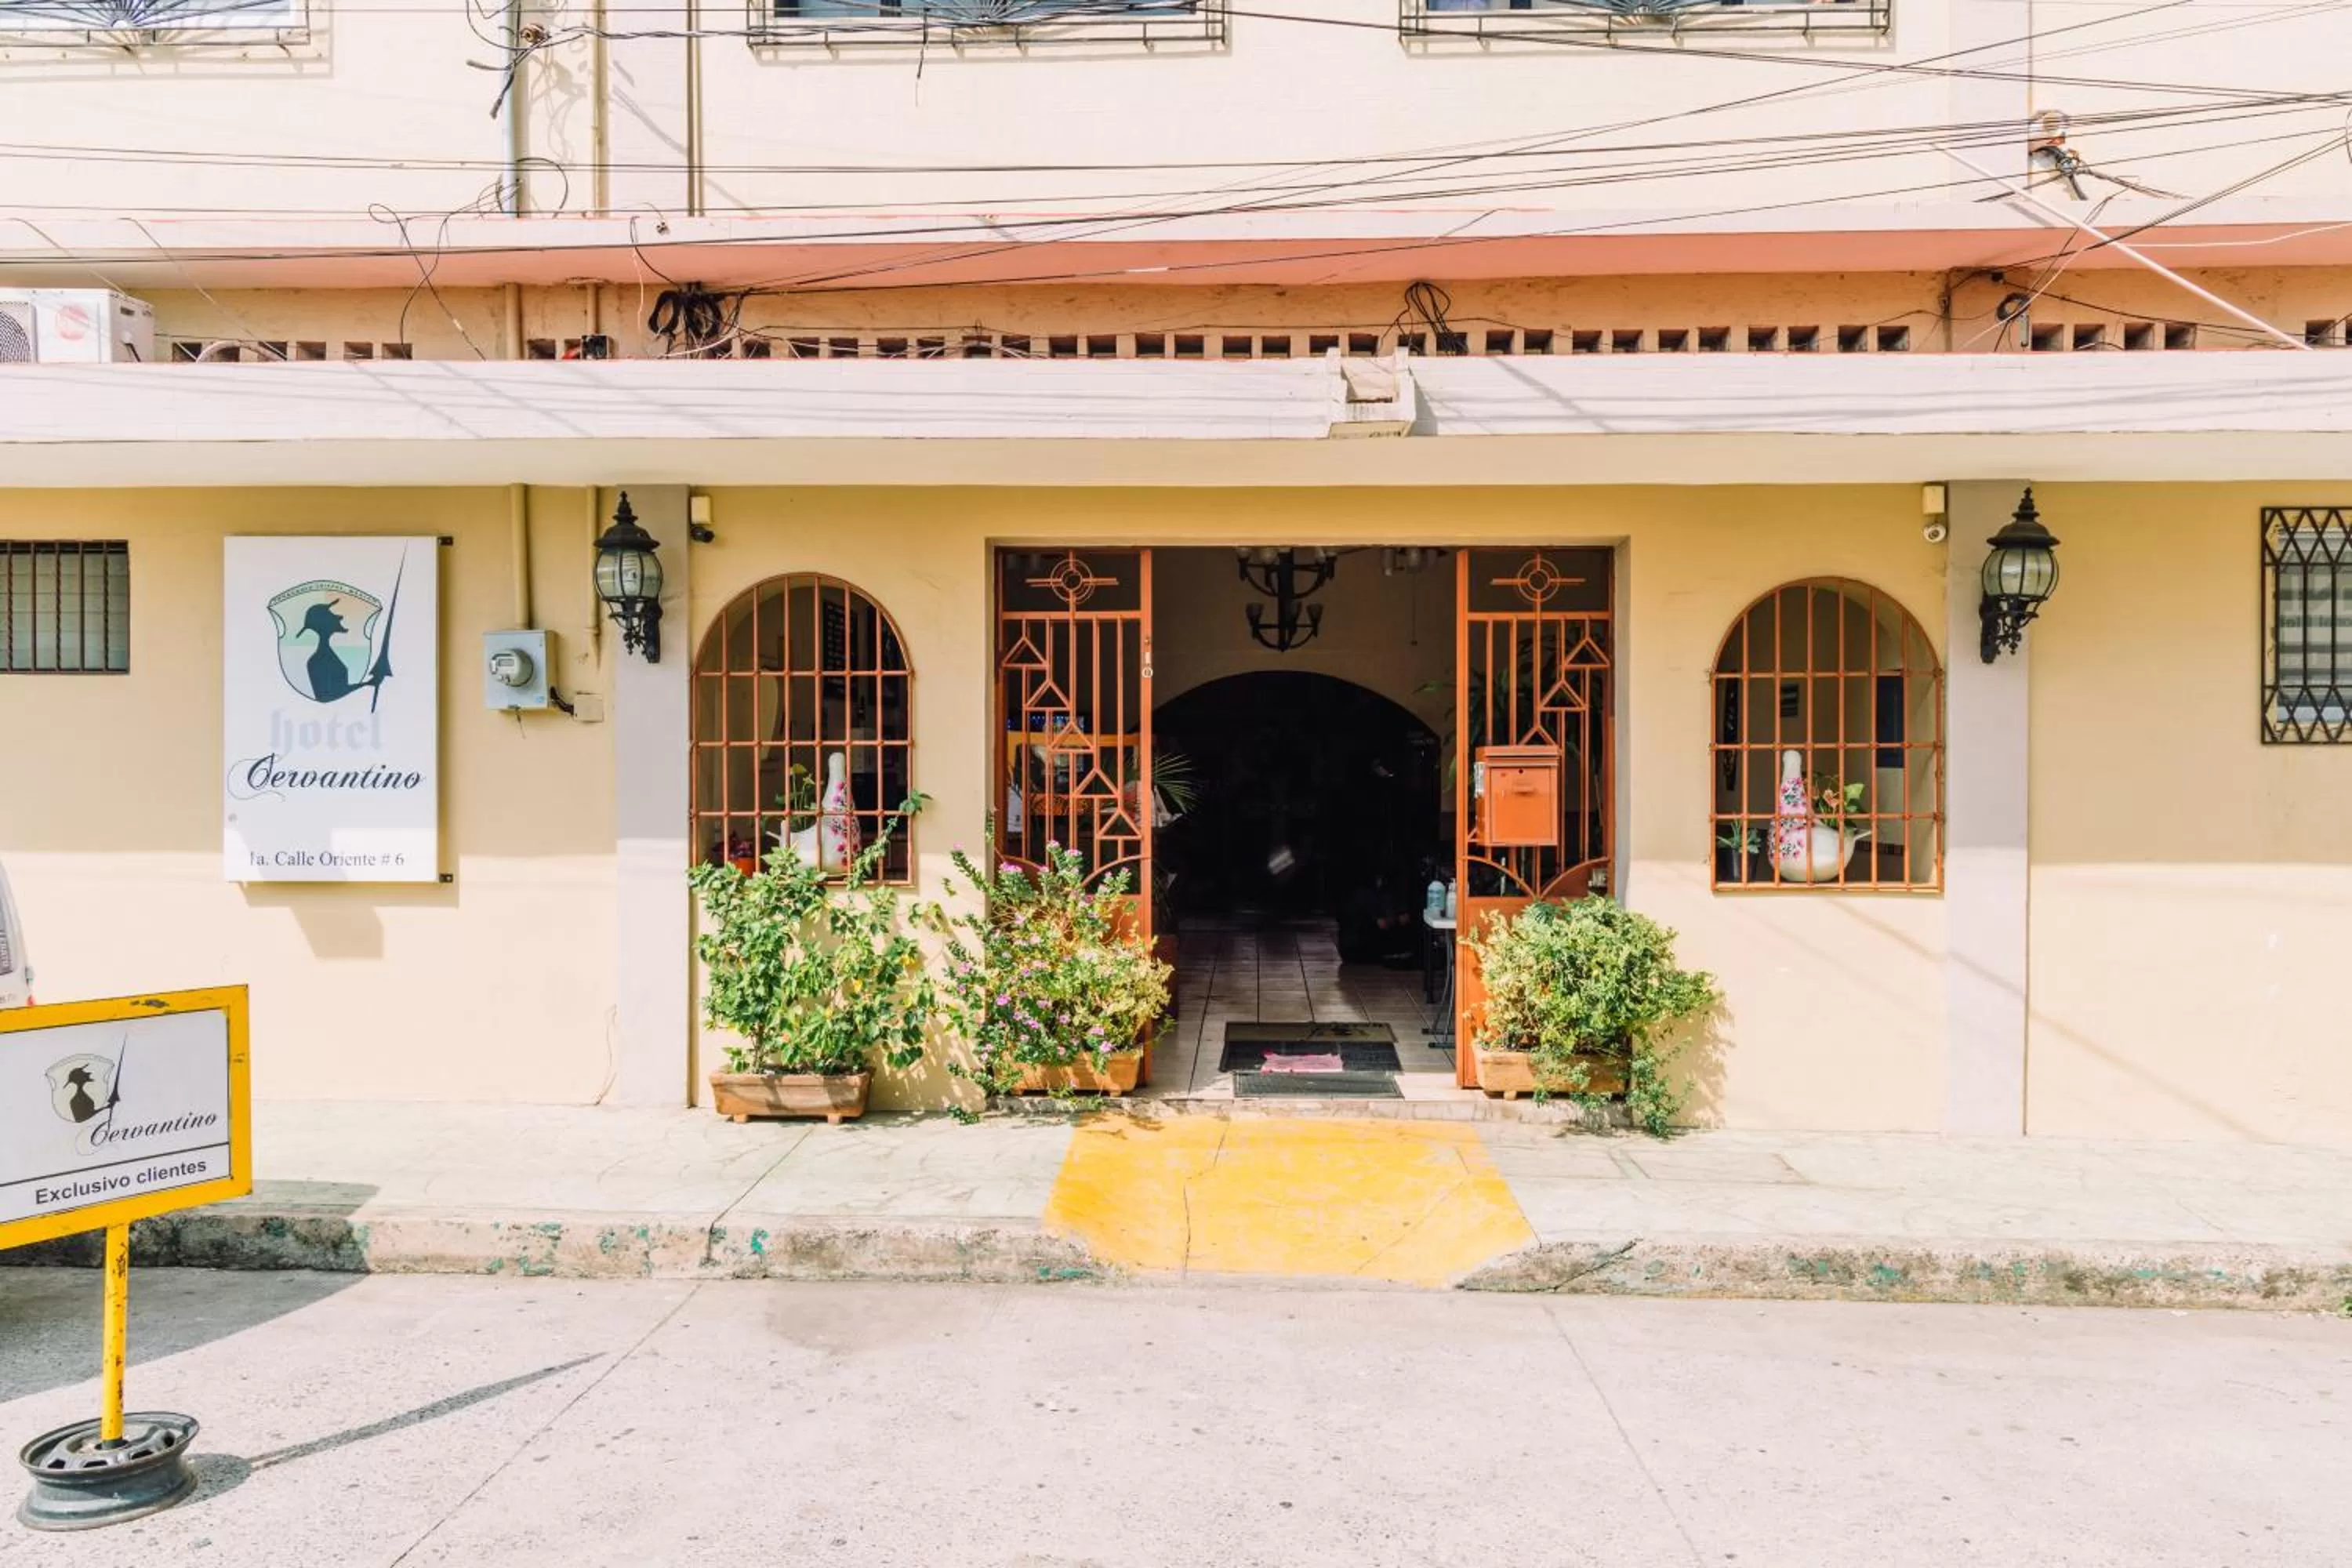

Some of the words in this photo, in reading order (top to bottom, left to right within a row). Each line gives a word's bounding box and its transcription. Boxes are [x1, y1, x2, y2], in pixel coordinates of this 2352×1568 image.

[270, 708, 383, 753] hotel
[229, 753, 426, 798] Cervantino
[275, 851, 314, 866] Calle
[319, 850, 376, 866] Oriente
[85, 1112, 218, 1148] Cervantino
[35, 1177, 131, 1205] Exclusivo
[136, 1160, 207, 1185] clientes
